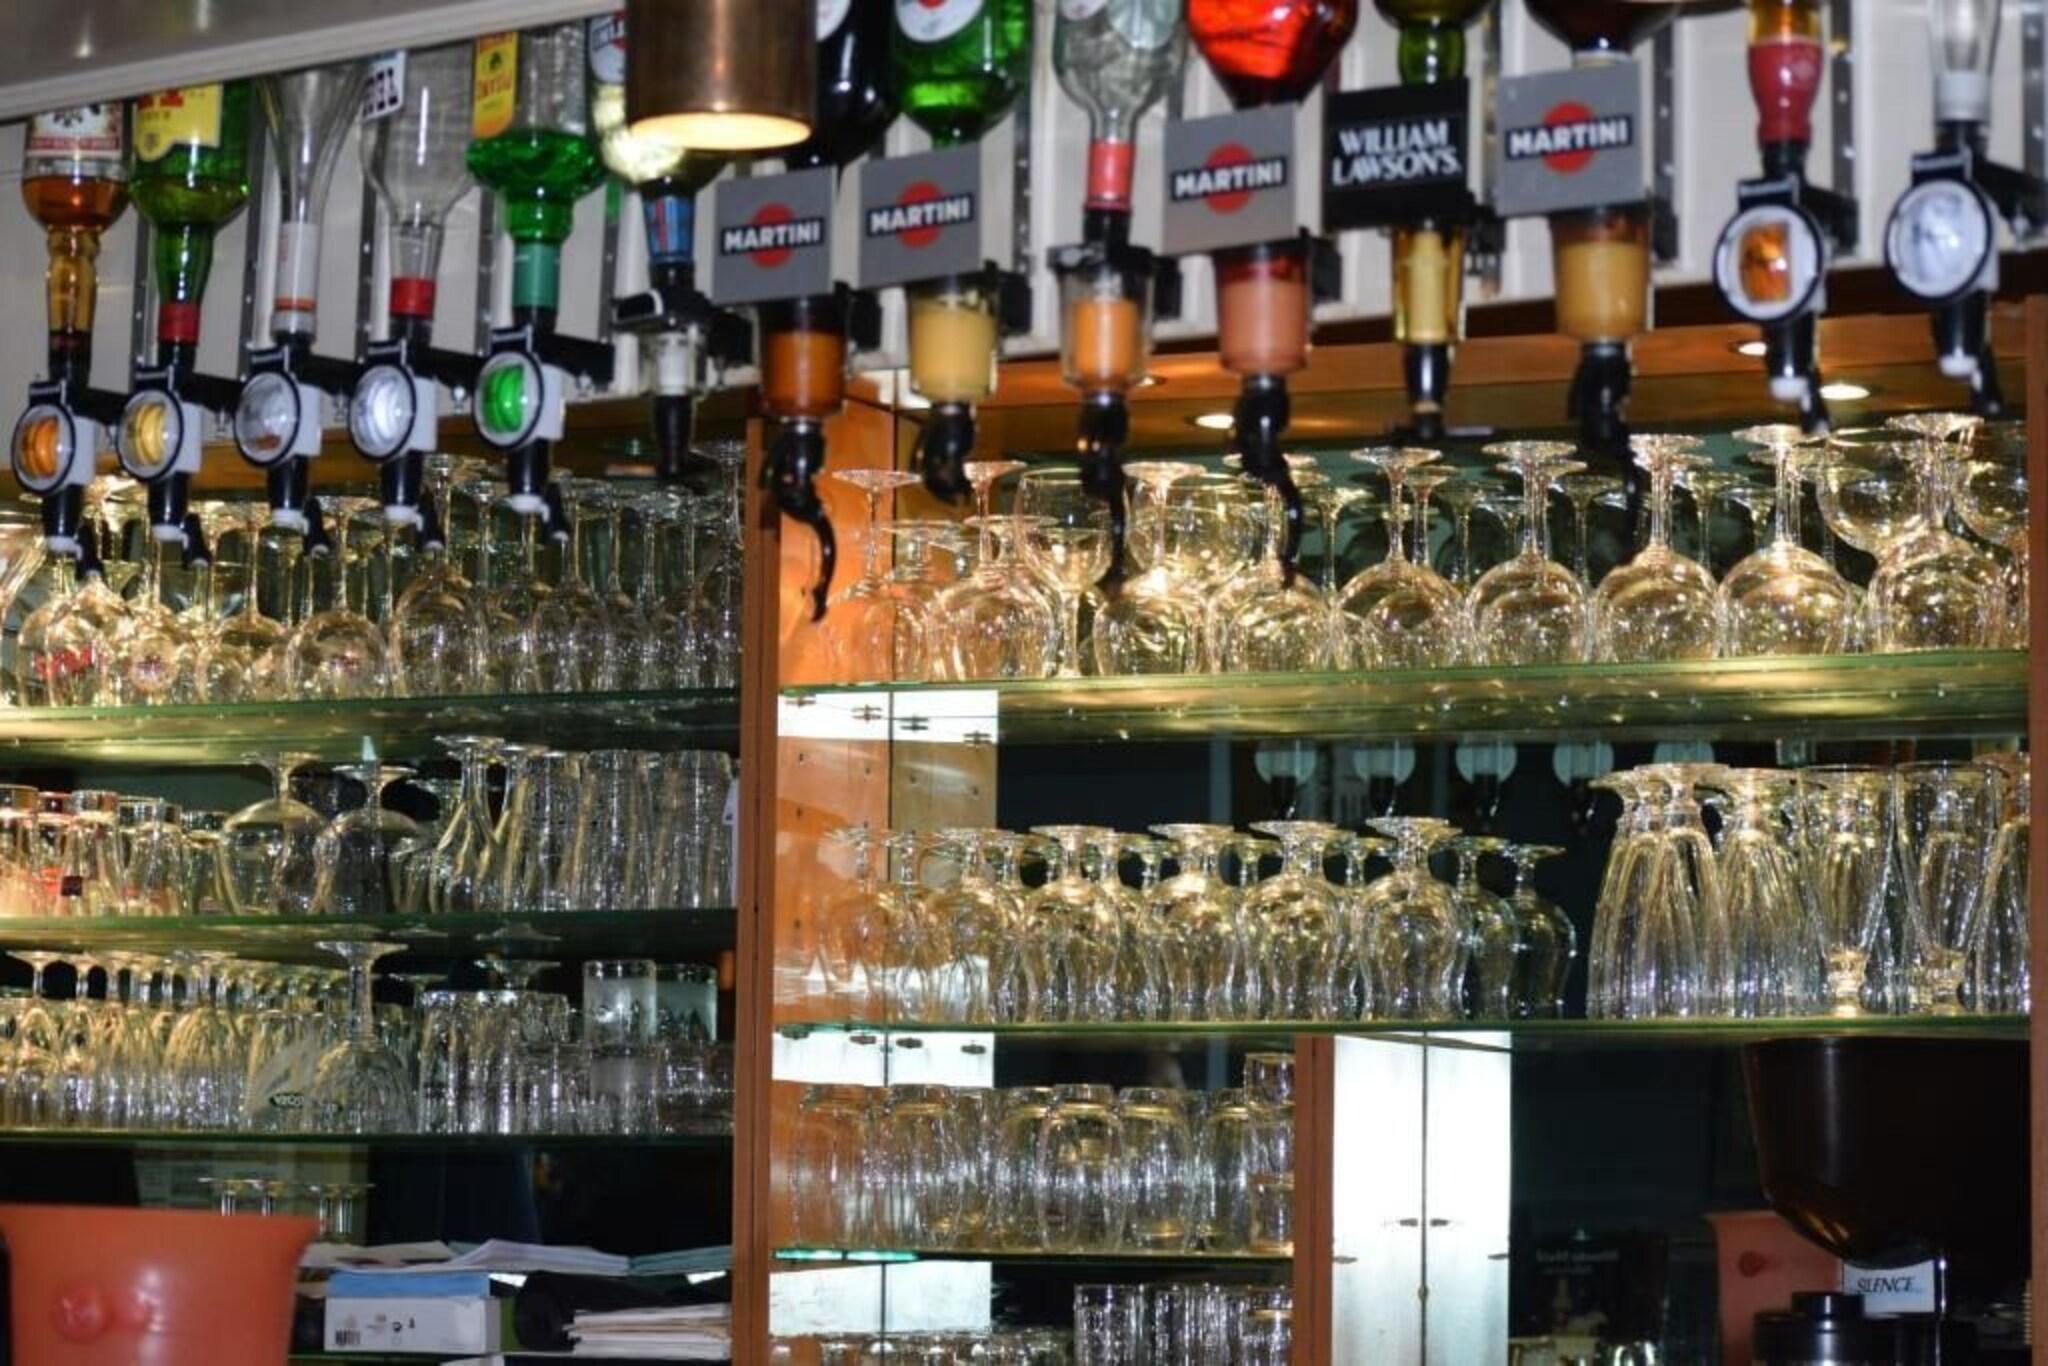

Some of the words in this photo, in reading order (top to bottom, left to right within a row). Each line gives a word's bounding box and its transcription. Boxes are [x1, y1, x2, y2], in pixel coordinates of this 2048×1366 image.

[1338, 119, 1449, 155] WILLIAM
[1510, 119, 1628, 156] MARTINI
[1175, 160, 1283, 197] MARTINI
[871, 198, 969, 233] MARTINI
[724, 221, 820, 250] MARTINI
